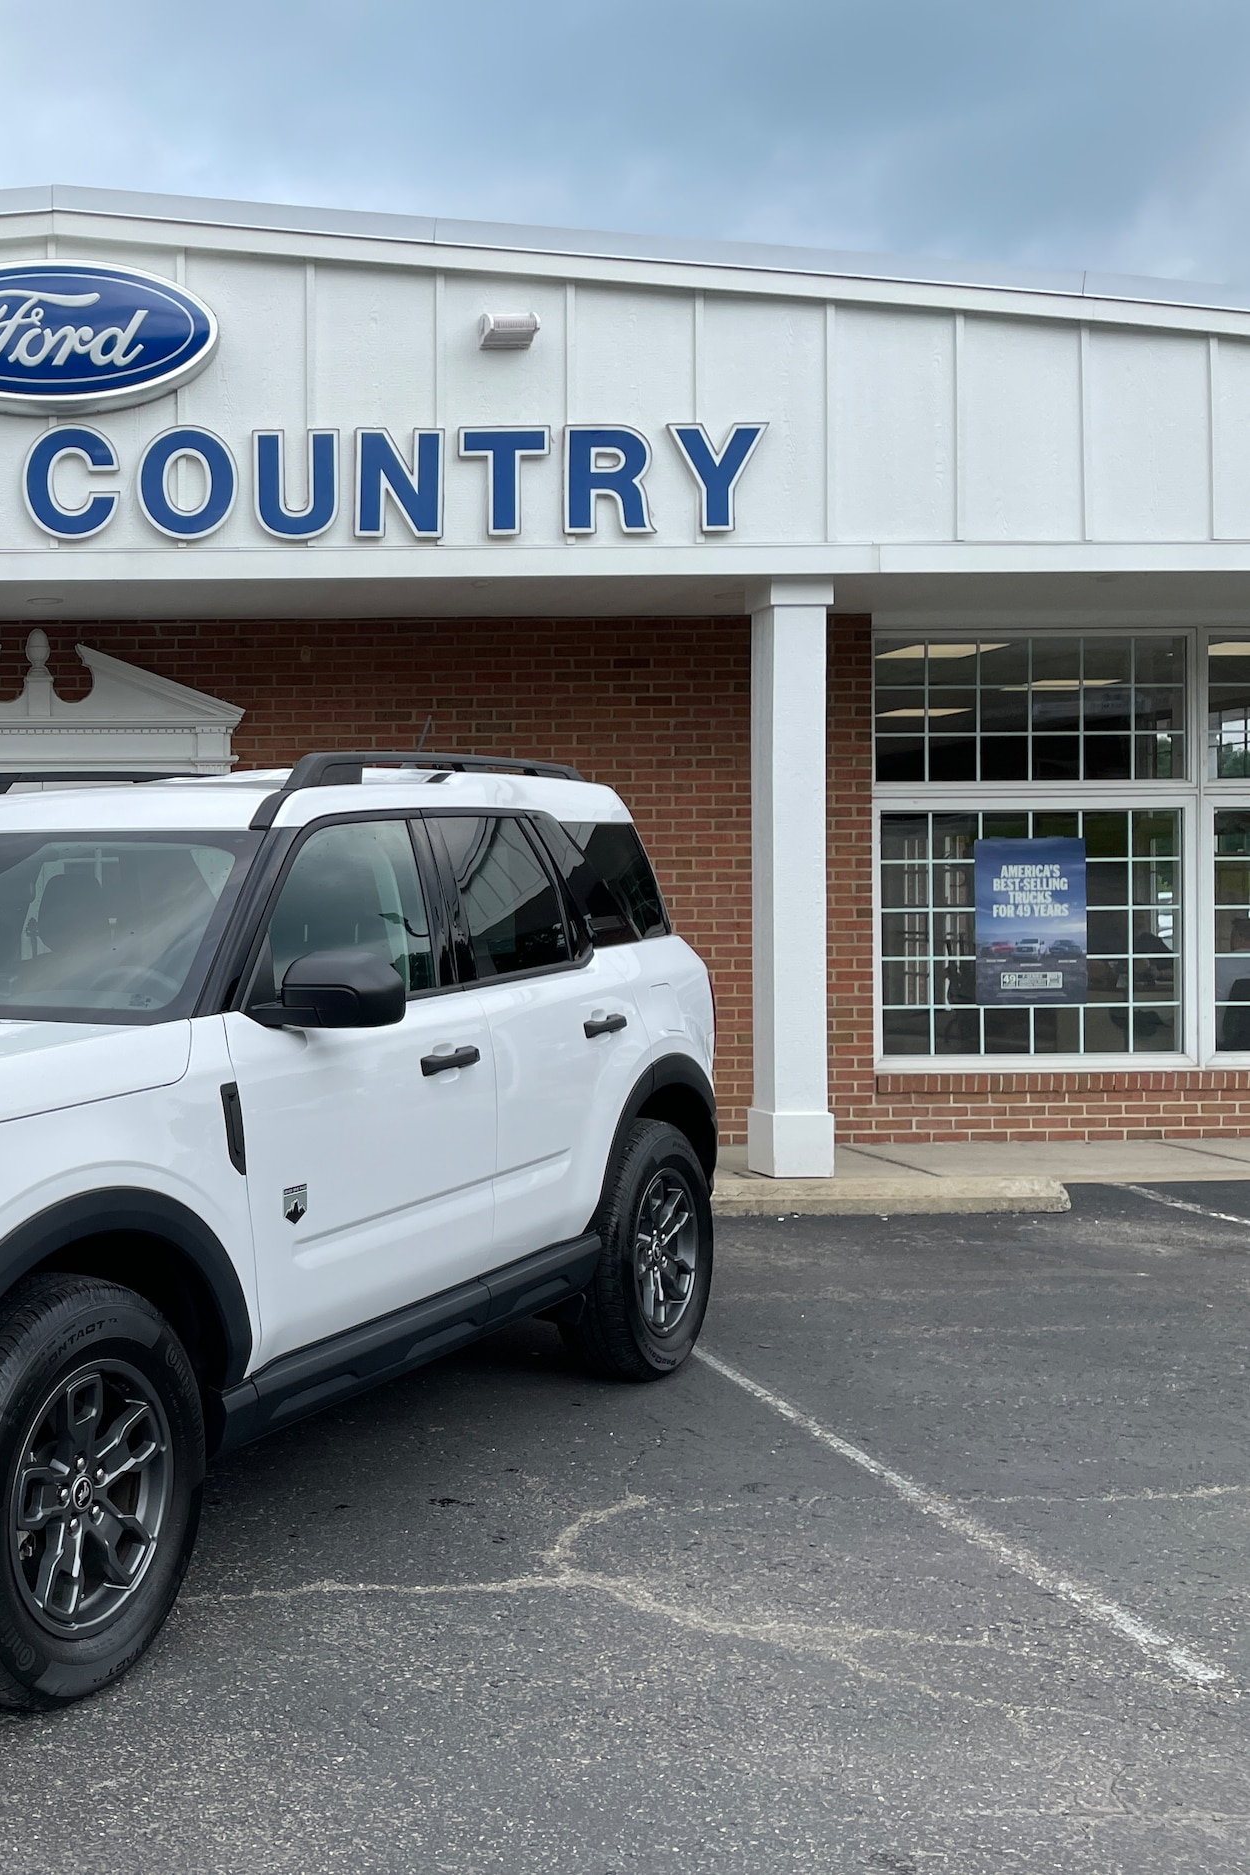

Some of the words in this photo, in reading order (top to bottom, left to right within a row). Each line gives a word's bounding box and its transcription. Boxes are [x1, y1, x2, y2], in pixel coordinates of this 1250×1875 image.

[23, 421, 770, 541] COUNTRY
[1001, 864, 1061, 878] AMERICA'S
[992, 877, 1068, 892] BEST-SELLING
[1008, 891, 1052, 904] TRUCKS
[992, 905, 1015, 918] FOR
[1016, 905, 1031, 917] 49
[1033, 904, 1069, 917] YEARS
